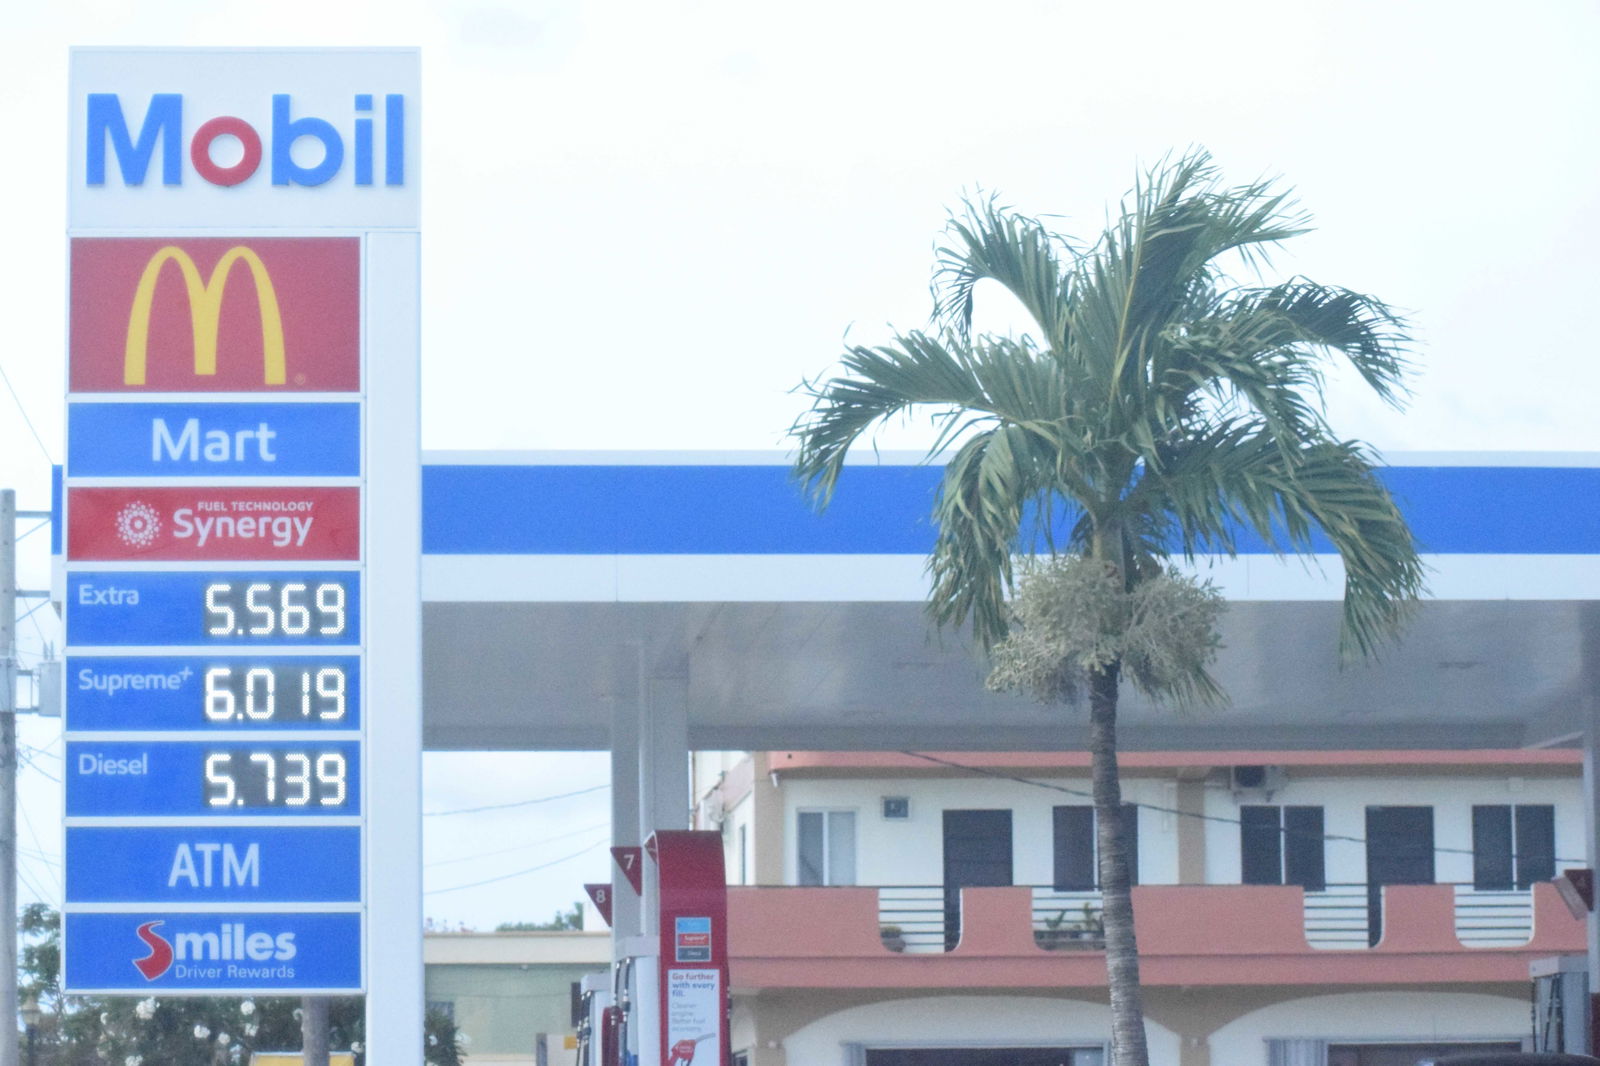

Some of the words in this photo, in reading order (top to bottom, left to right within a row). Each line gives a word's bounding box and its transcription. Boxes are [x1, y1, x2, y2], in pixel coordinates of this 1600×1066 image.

[87, 93, 405, 188] Mobil
[152, 418, 277, 462] Mart
[198, 502, 227, 512] FUEL
[232, 501, 313, 512] TECHNOLOGY
[173, 509, 313, 547] Synergy
[79, 584, 139, 605] Extra
[206, 583, 345, 635] 5.569
[205, 668, 345, 719] 6.019
[79, 753, 147, 775] Diesel
[206, 753, 346, 806] 5.739
[167, 843, 260, 887] ATM
[623, 853, 635, 870] 7
[596, 889, 606, 904] 8
[132, 920, 297, 981] Smiles
[175, 965, 222, 979] Driver
[228, 965, 296, 979] Rewards
[686, 972, 714, 980] further
[692, 982, 715, 991] every
